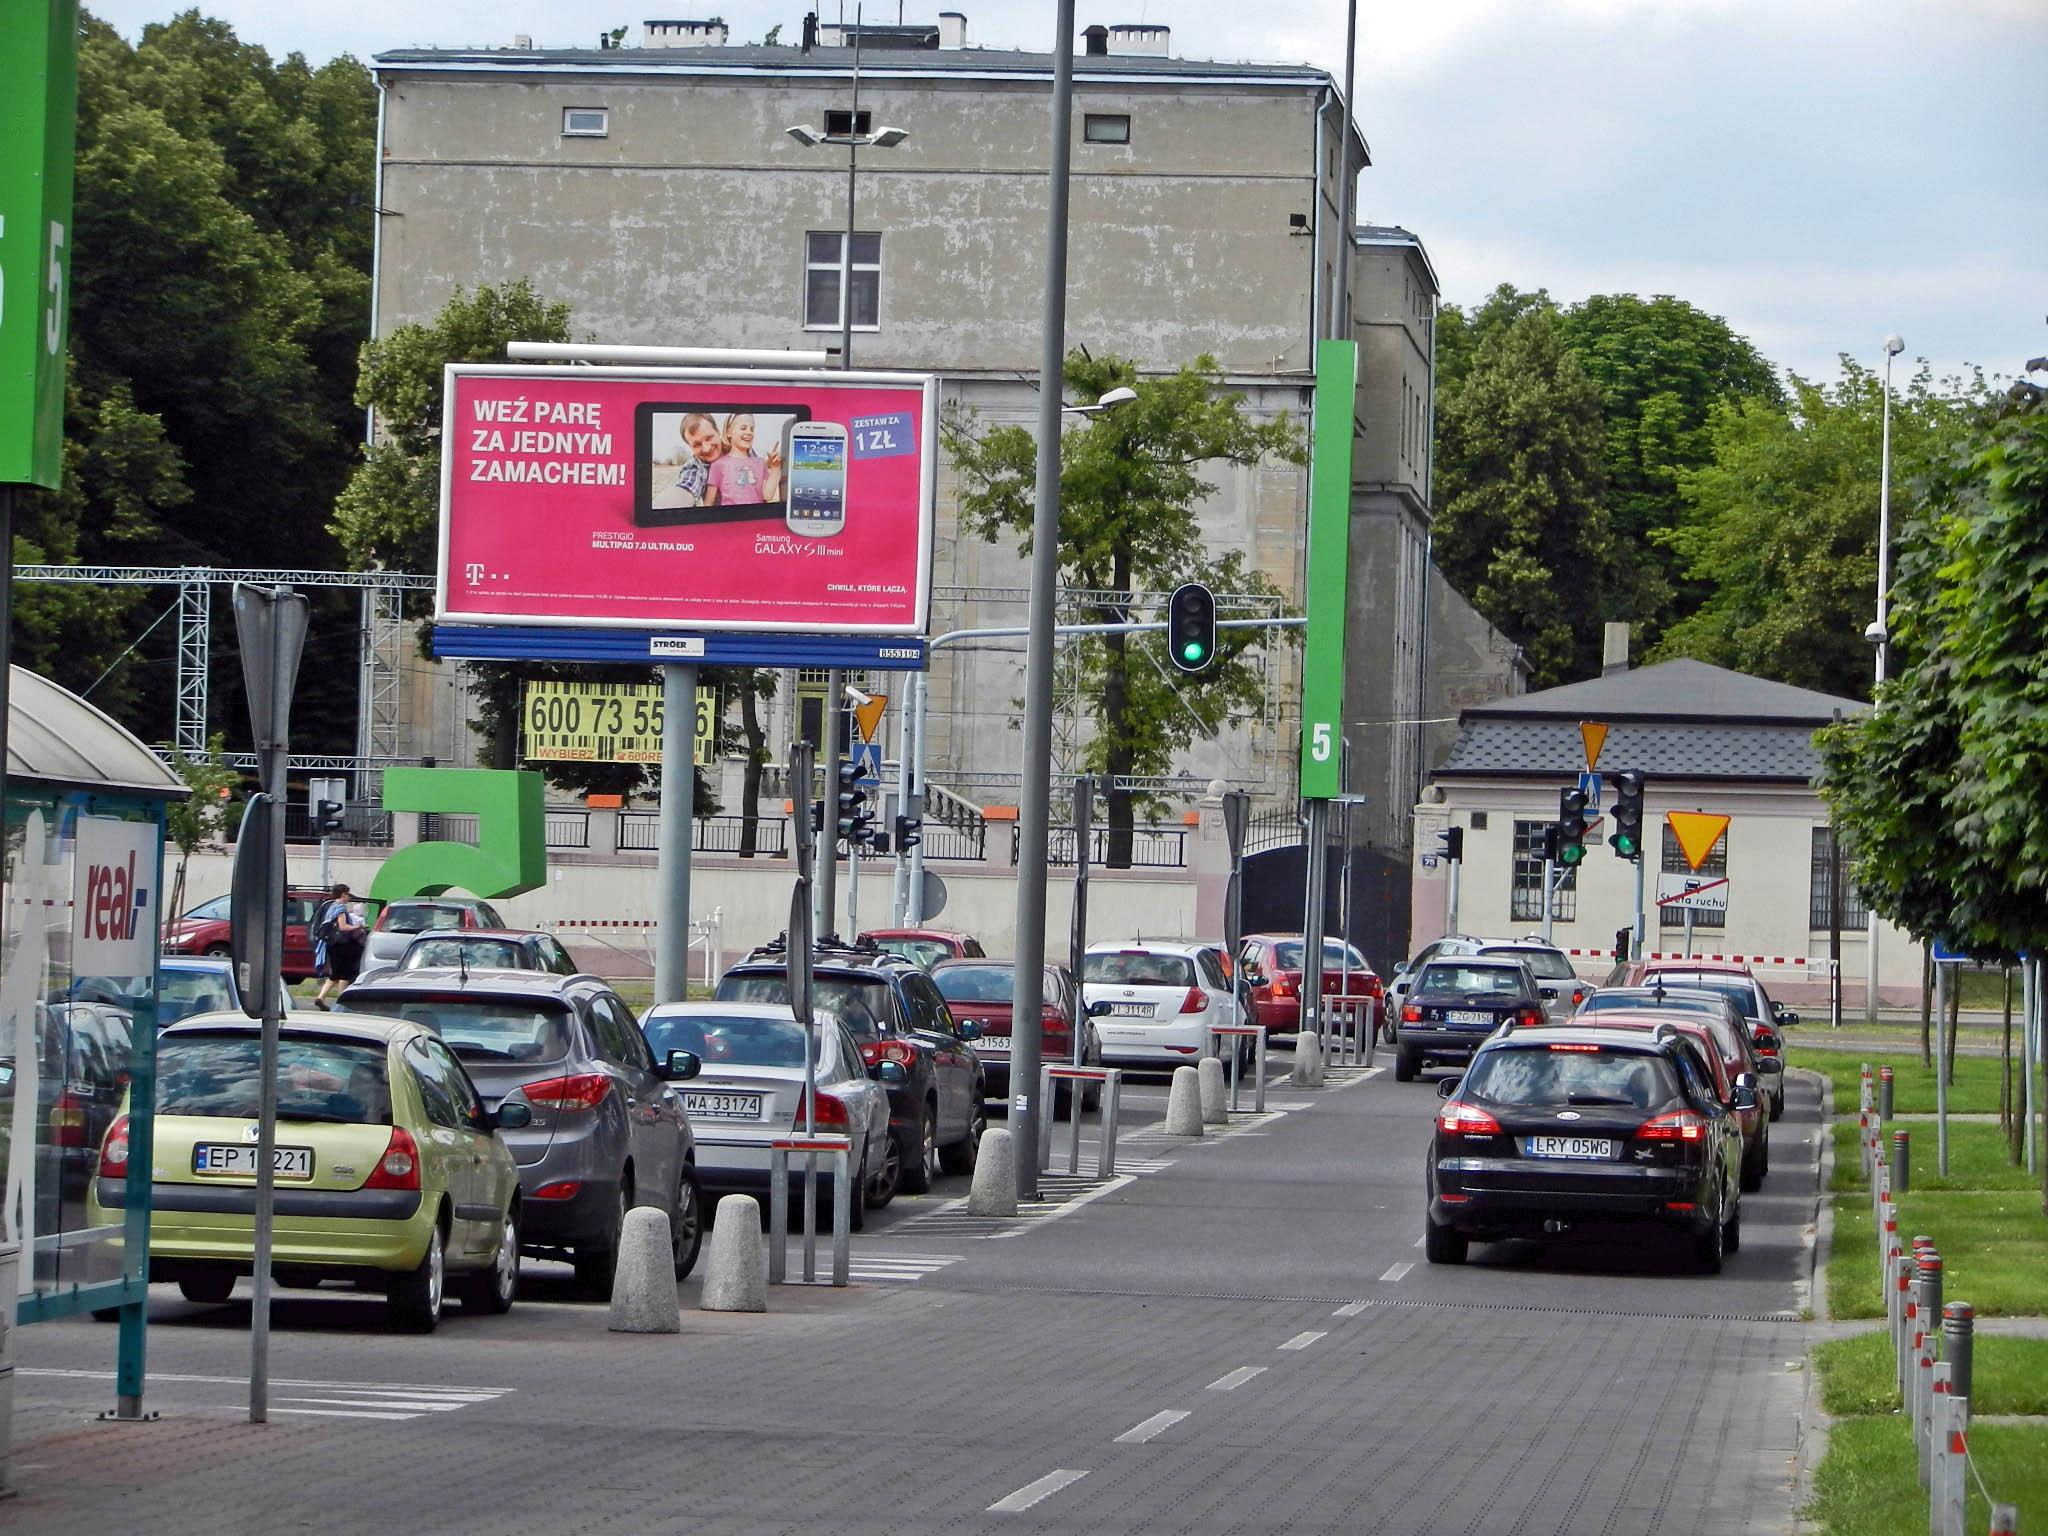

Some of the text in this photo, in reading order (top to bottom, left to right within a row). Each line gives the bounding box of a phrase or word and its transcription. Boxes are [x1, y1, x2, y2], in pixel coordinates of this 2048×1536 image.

[47, 220, 65, 356] 5
[473, 395, 602, 431] WEŹ PARĘ
[854, 416, 900, 428] ZESTAW ZA
[471, 430, 612, 455] ZA JEDNYM
[855, 430, 897, 451] 1 ZŁ
[802, 444, 836, 454] 12:45
[470, 459, 626, 486] ZAMACHEM!
[592, 531, 634, 541] PRESTIGIO
[755, 533, 791, 543] Samsung
[591, 540, 695, 552] MULTIPAD 7.0 ULTRA DUO
[754, 542, 802, 555] GALAXY
[826, 583, 857, 593] CHWILE,
[857, 583, 882, 593] KTÓRE
[531, 696, 581, 734] 600
[591, 698, 623, 735] 73
[1311, 723, 1331, 762] 5
[538, 748, 594, 760] WYBIERZ
[1696, 897, 1725, 907] ruchu
[980, 1037, 1011, 1048] 31563
[687, 1095, 757, 1112] WA 33174
[1536, 1137, 1609, 1155] LRY 05WG
[210, 1148, 306, 1171] EP 1221
